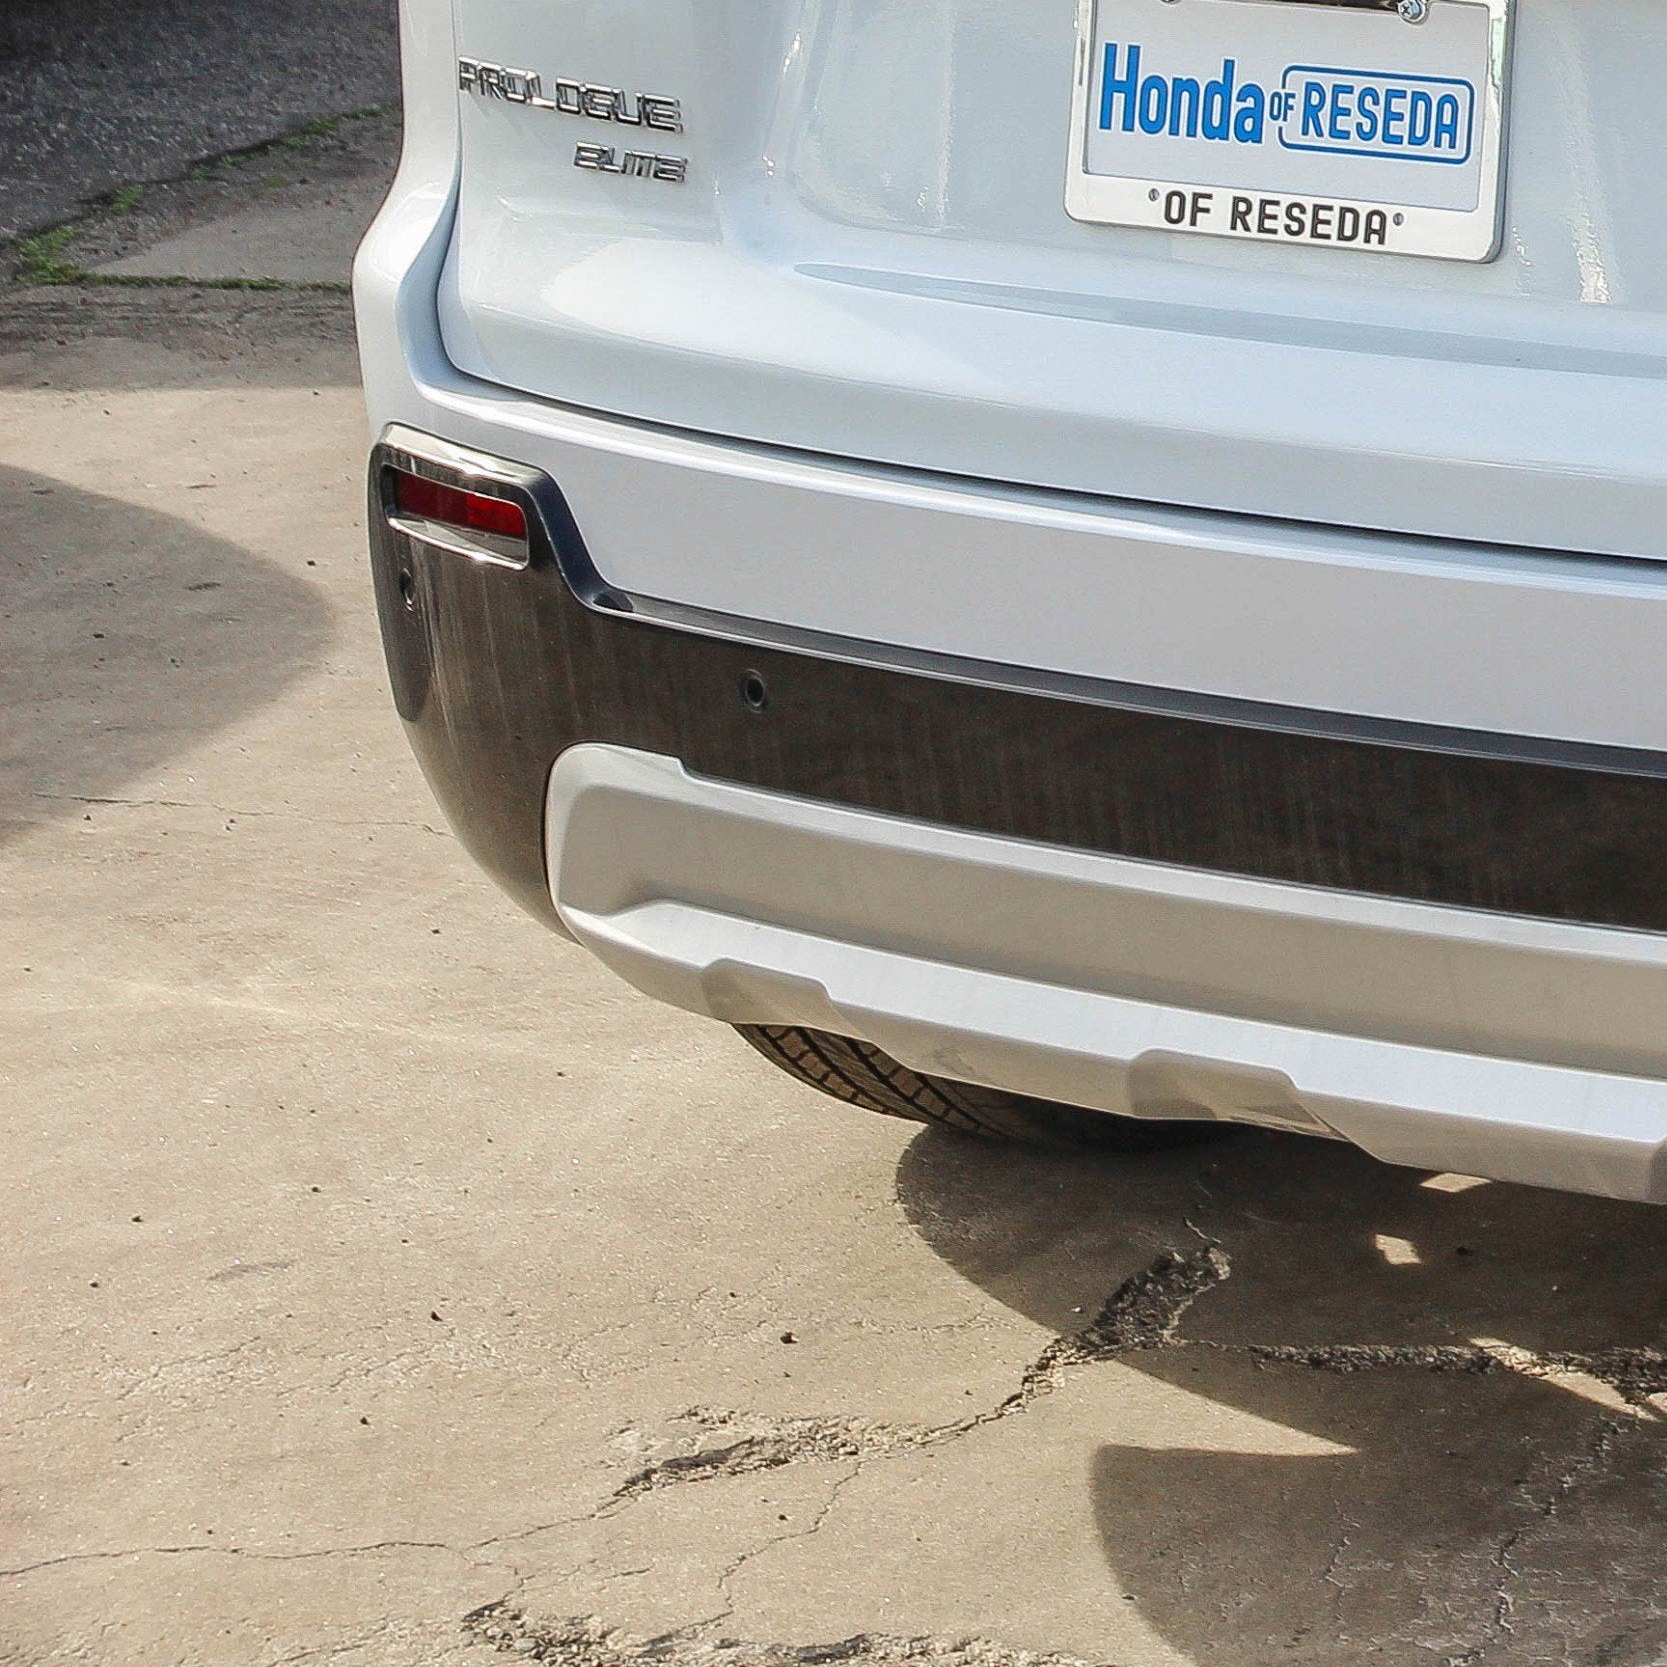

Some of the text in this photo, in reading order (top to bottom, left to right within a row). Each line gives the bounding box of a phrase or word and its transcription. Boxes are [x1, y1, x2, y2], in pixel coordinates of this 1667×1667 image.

[457, 54, 685, 135] PROLOGUE
[1099, 42, 1460, 150] Honda OF RESEDA
[573, 140, 689, 184] ELITE
[1163, 189, 1388, 246] OF RESEDA
